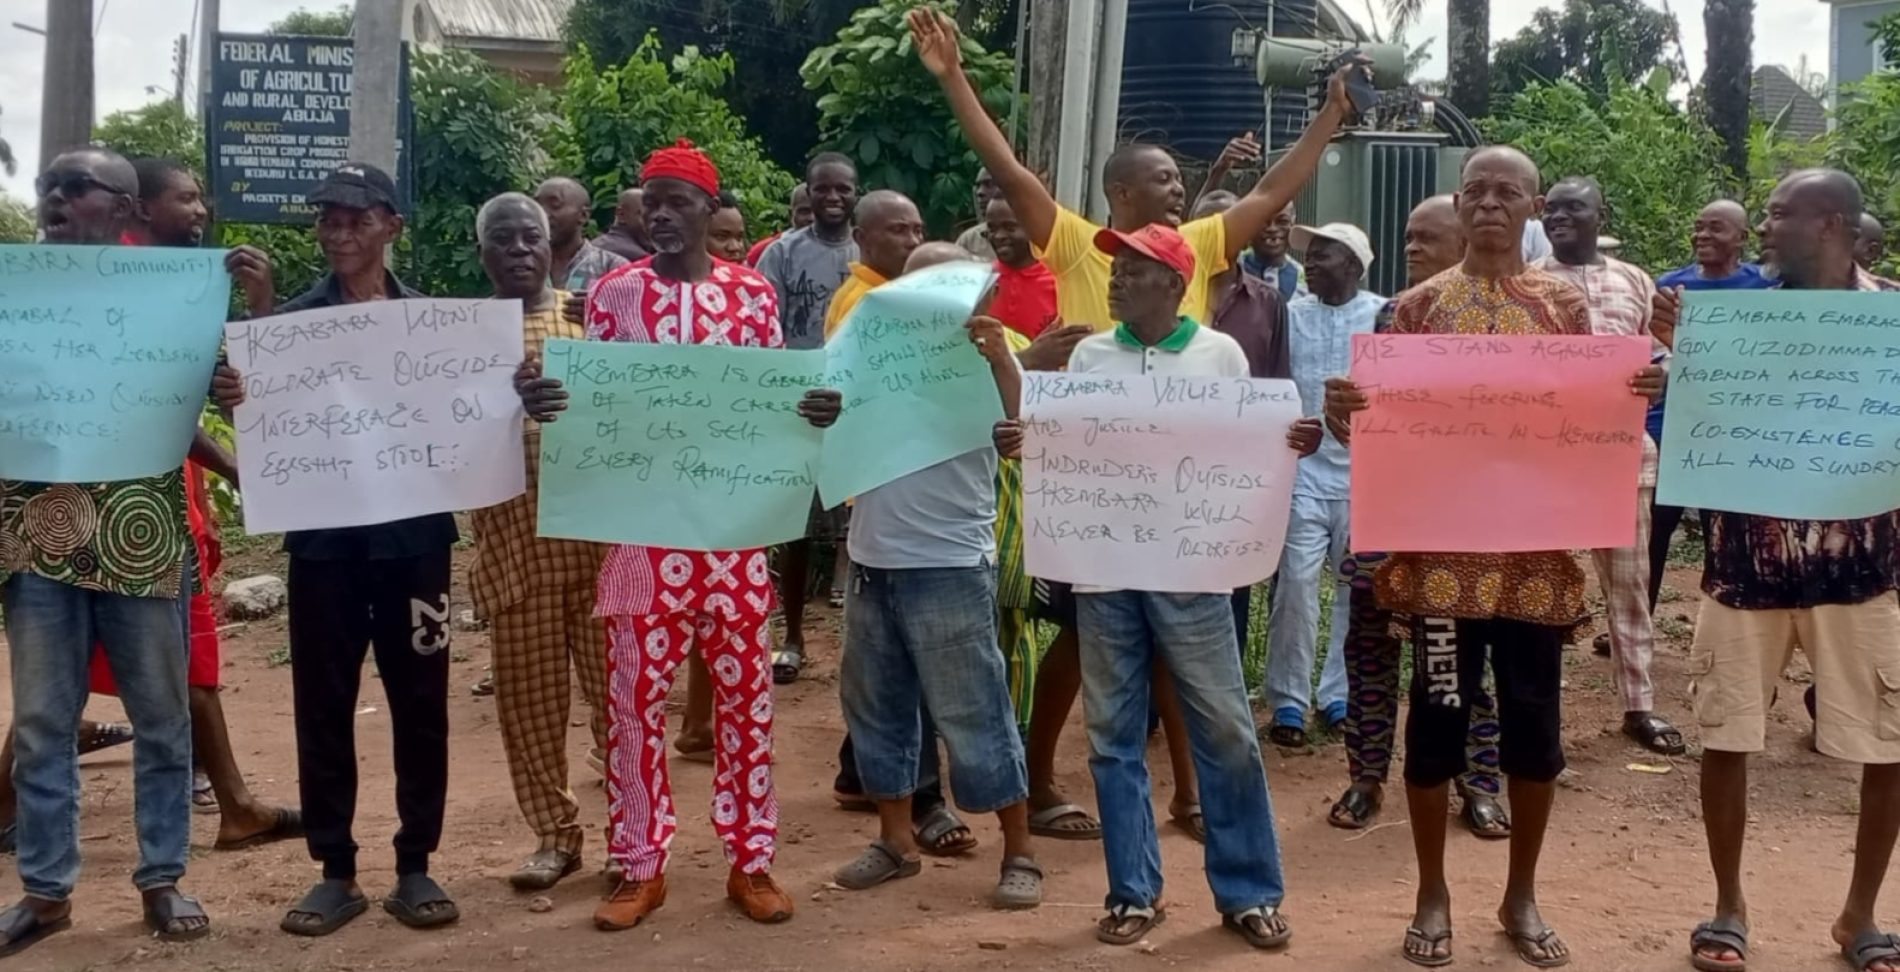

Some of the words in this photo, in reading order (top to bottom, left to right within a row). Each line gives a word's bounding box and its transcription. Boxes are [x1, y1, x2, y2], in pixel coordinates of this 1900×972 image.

[220, 41, 294, 63] FEDERAL
[240, 69, 257, 89] OF
[222, 92, 249, 107] AND
[252, 93, 299, 109] RURAL
[282, 109, 335, 124] ABUJA
[244, 133, 297, 145] PROVISION
[298, 135, 311, 145] OF
[220, 144, 277, 156] IRRIGATION
[280, 146, 306, 156] CROP
[1425, 336, 1512, 356] STAND
[1677, 337, 1718, 357] GOV
[1731, 338, 1877, 357] UZODIMMA
[1676, 366, 1771, 383] AGENDA
[1788, 369, 1860, 383] ACROSS
[1707, 391, 1784, 407] STATE
[1794, 392, 1850, 411] FOR
[1681, 448, 1735, 470] ALL
[1748, 453, 1795, 472] AND
[410, 592, 450, 656] 23
